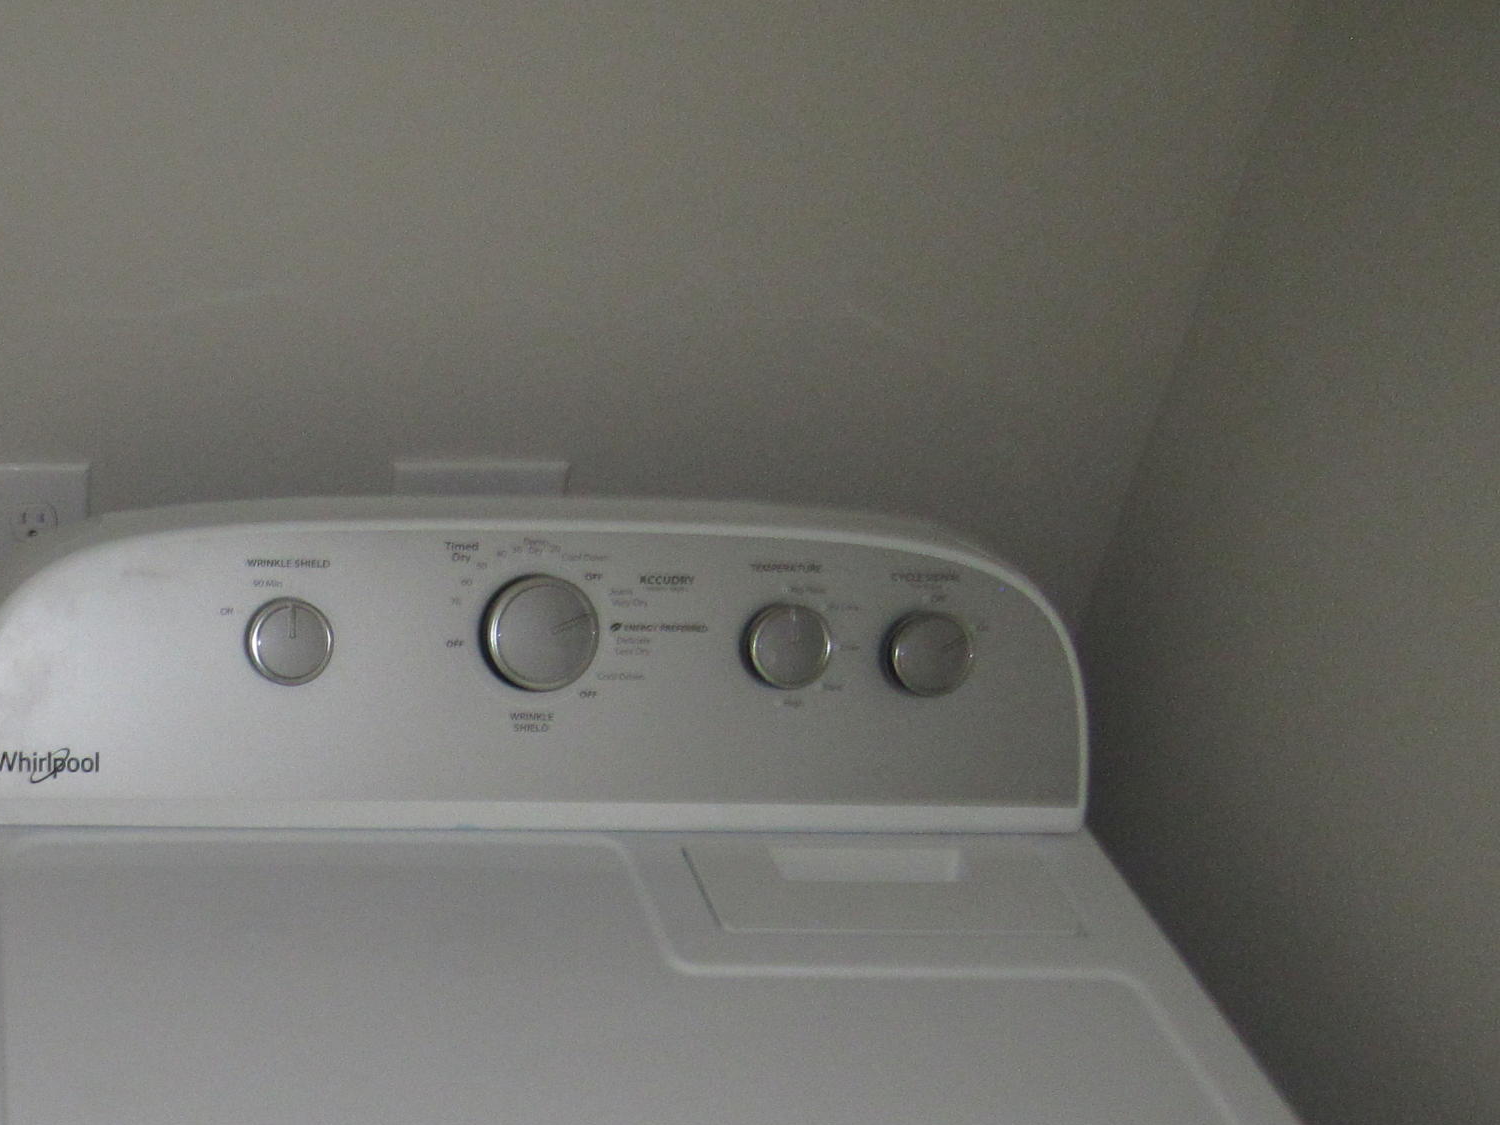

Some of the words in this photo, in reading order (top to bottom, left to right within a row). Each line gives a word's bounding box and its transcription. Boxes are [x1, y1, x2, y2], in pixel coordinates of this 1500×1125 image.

[443, 540, 479, 551] Timed
[450, 551, 471, 564] Dry
[245, 558, 291, 569] WRINKLE
[294, 558, 331, 569] SHIELD
[639, 573, 695, 585] ACCUDRY
[445, 639, 464, 648] OFF
[580, 690, 597, 699] OFF
[509, 712, 554, 722] WRINKLE
[513, 723, 550, 732] SHIELD
